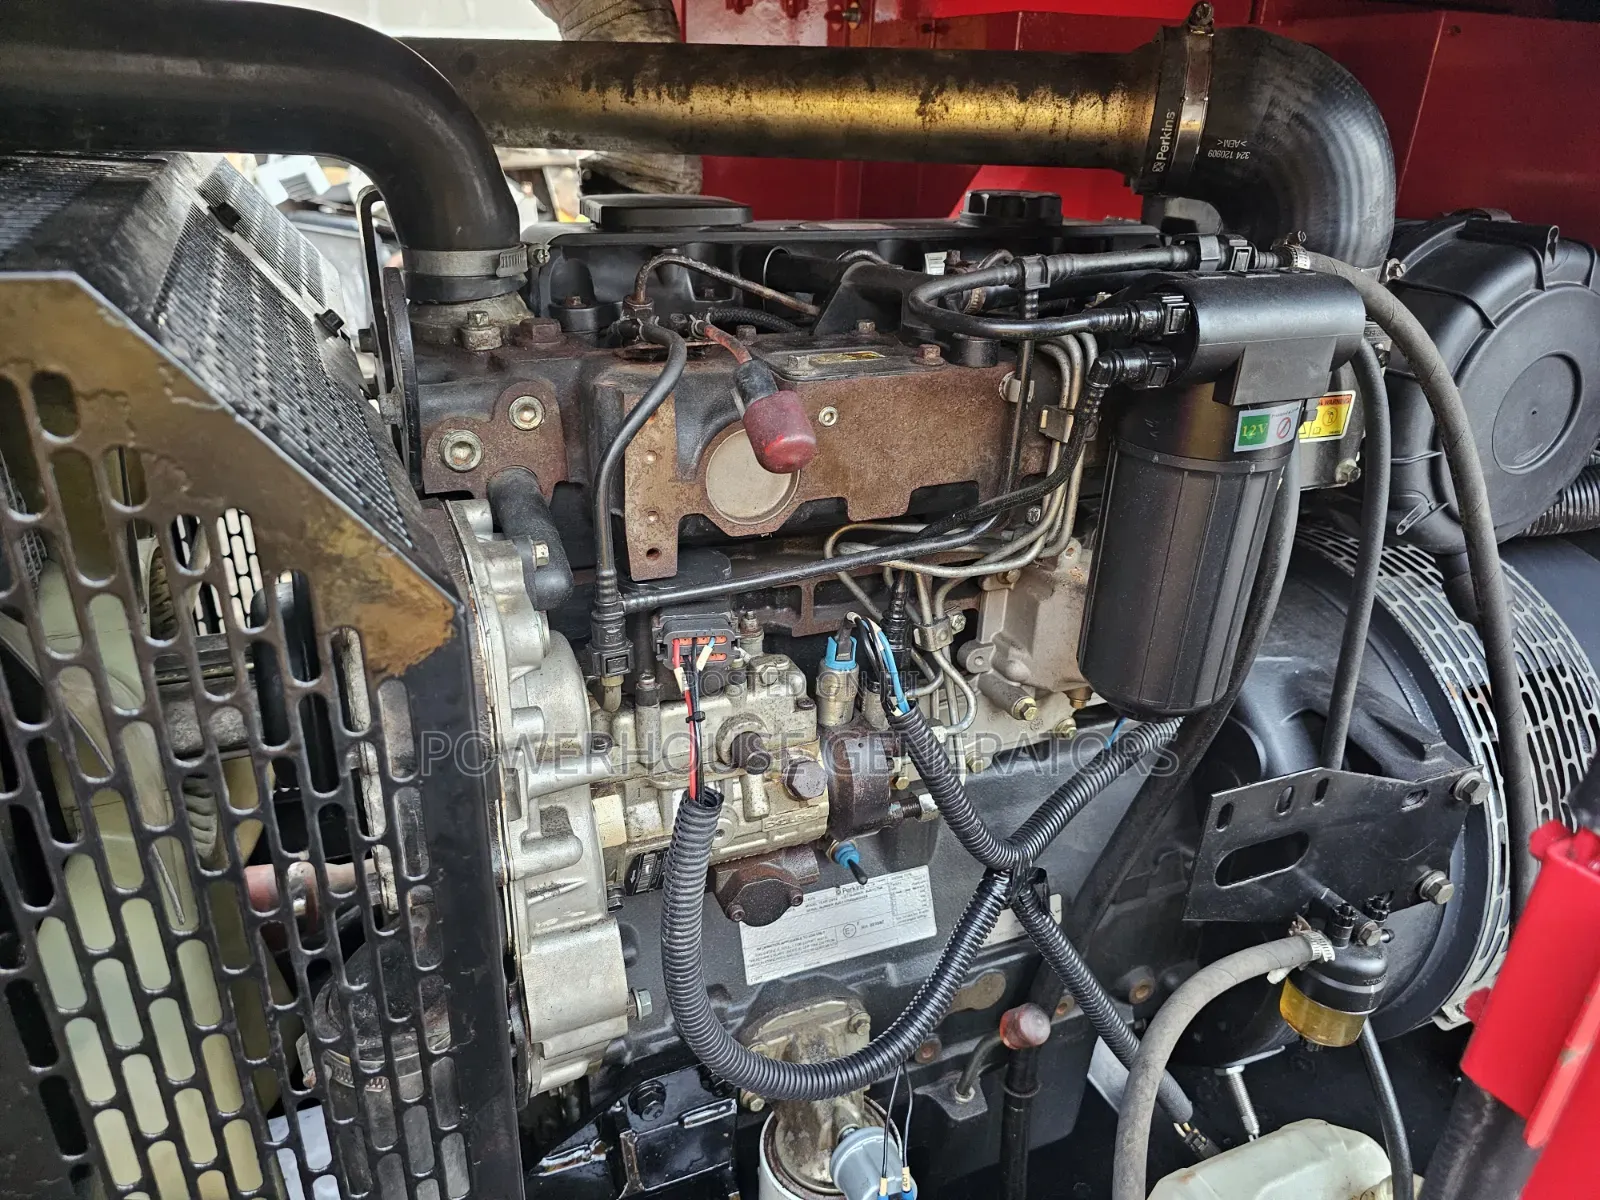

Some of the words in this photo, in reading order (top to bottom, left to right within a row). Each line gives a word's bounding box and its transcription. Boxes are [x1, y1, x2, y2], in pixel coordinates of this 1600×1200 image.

[1156, 111, 1176, 161] Perkins
[1236, 151, 1250, 160] 324
[1242, 422, 1269, 438] 12V
